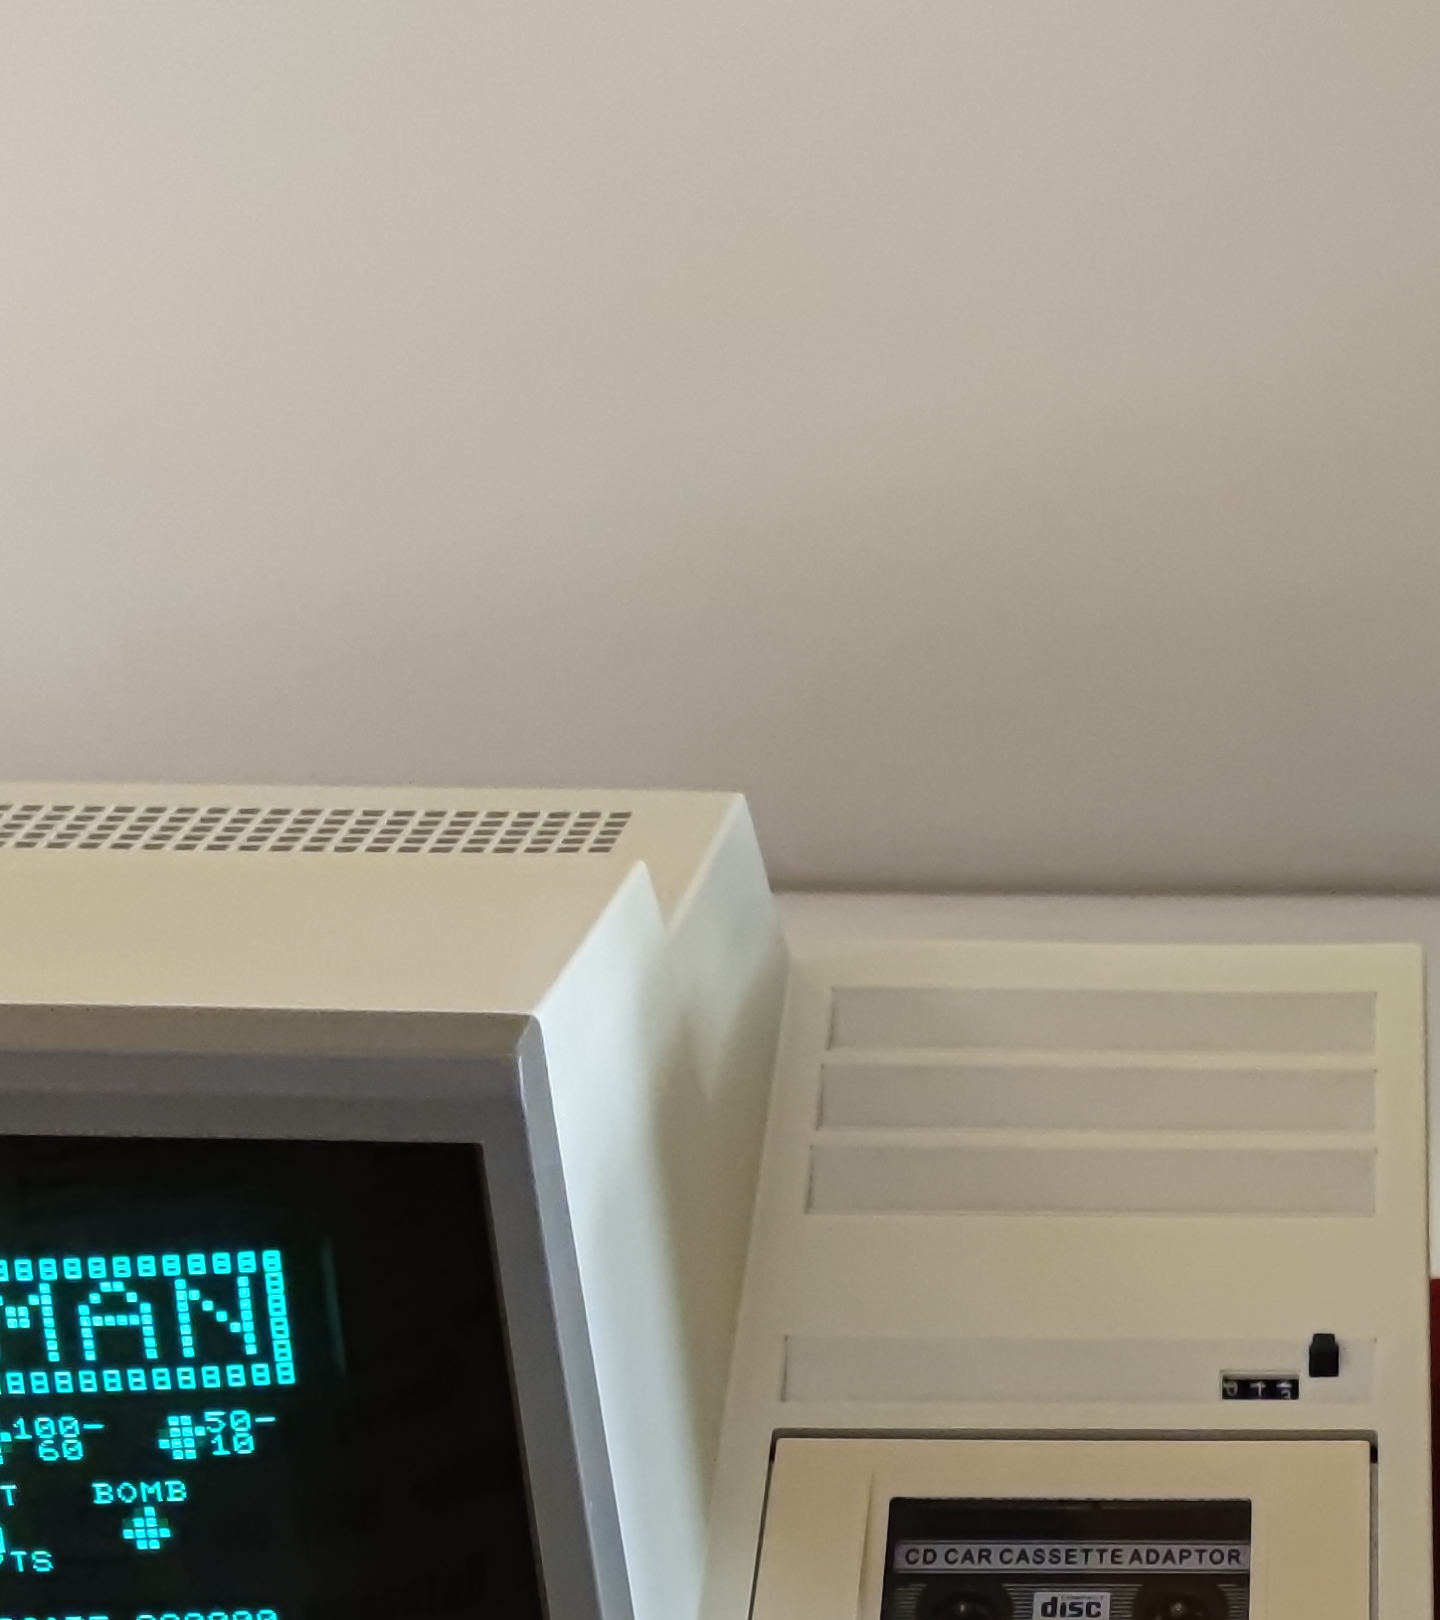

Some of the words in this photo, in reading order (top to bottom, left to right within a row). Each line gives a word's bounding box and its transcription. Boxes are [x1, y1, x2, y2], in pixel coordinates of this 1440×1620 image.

[38, 1440, 85, 1462] 60
[211, 1434, 255, 1456] 10
[91, 1480, 188, 1505] BOMB
[905, 1548, 937, 1566] CD
[944, 1548, 993, 1566] CAR
[998, 1548, 1125, 1566] CASSETTE
[1128, 1548, 1243, 1566] ADAPTOR
[1041, 1596, 1102, 1618] disc
